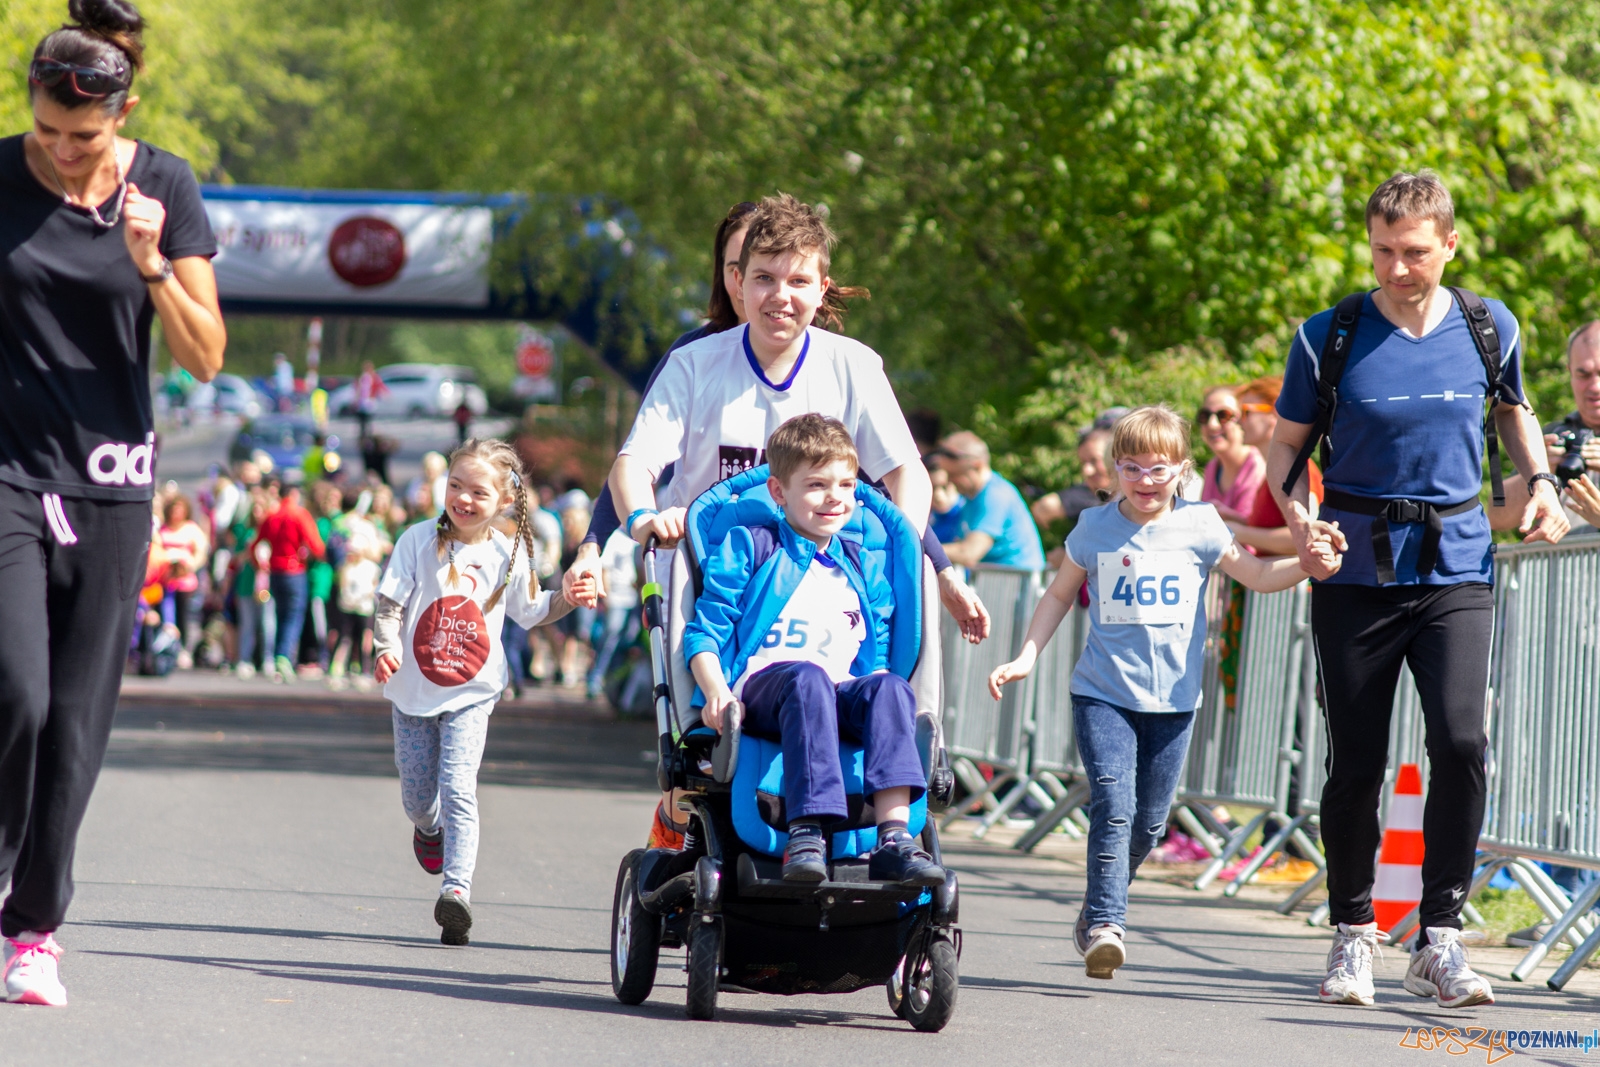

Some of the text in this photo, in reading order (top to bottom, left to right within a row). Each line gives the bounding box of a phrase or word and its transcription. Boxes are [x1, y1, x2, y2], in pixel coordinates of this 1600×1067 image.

[1111, 575, 1180, 606] 466
[438, 607, 478, 642] bieg
[447, 631, 463, 642] na
[446, 641, 467, 657] tak
